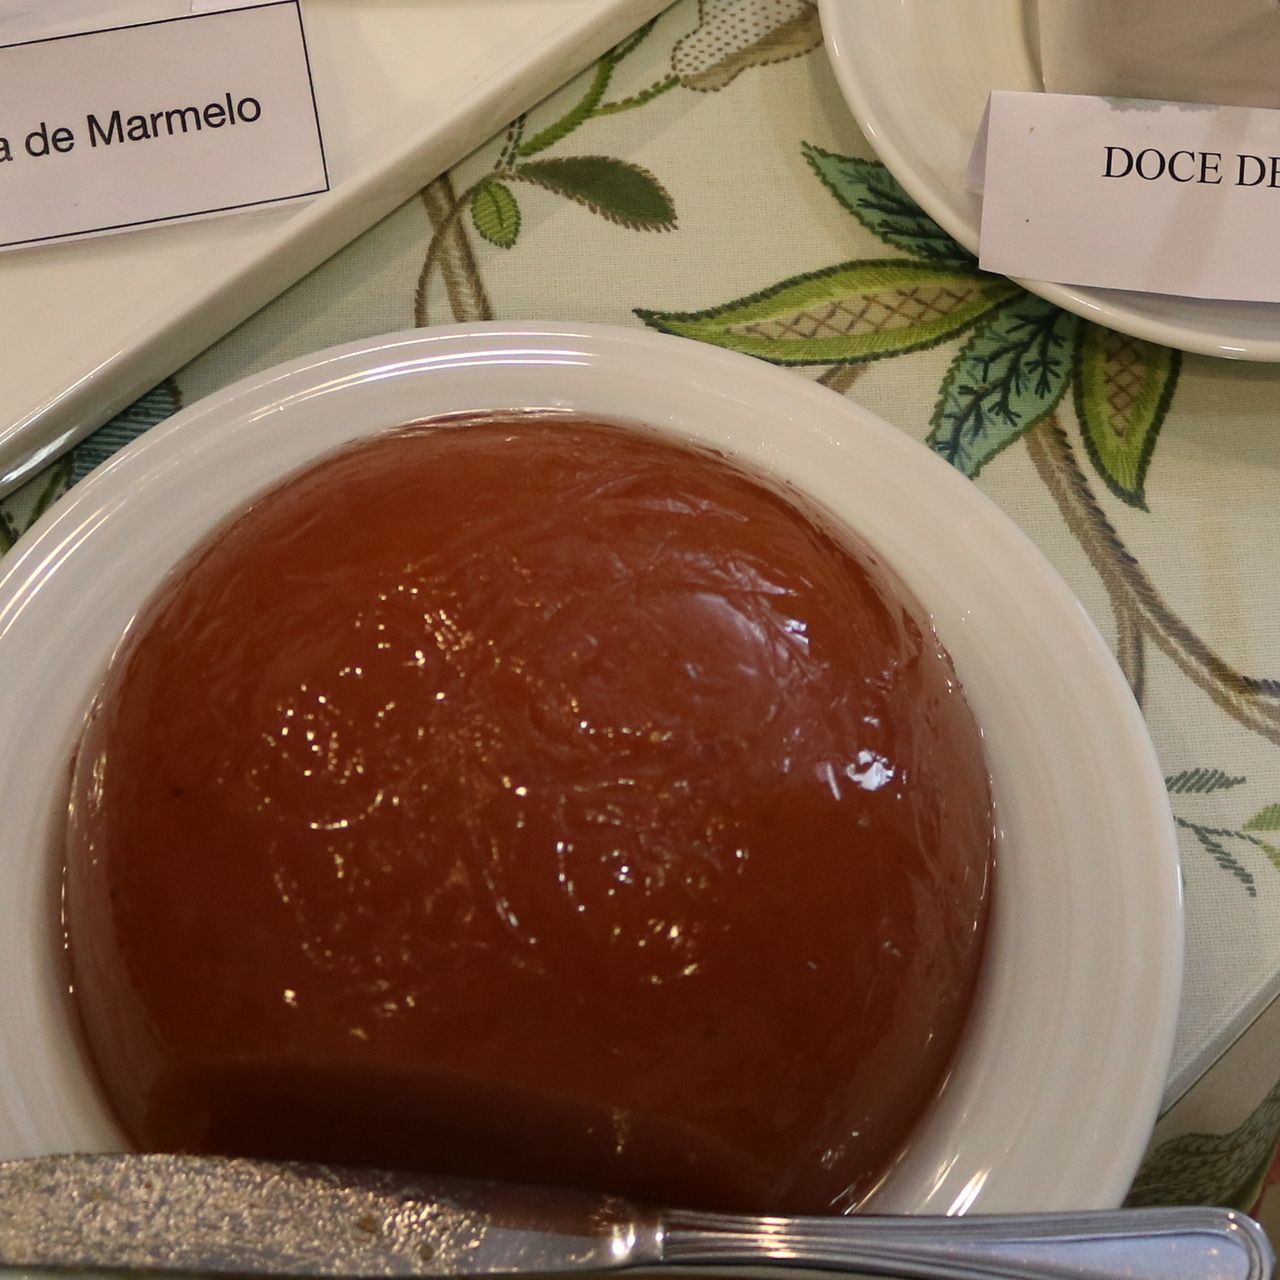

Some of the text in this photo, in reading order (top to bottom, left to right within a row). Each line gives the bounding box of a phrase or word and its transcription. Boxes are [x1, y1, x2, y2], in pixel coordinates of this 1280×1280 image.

[25, 121, 75, 158] de
[86, 92, 262, 148] Marmelo
[1102, 145, 1223, 186] DOCE
